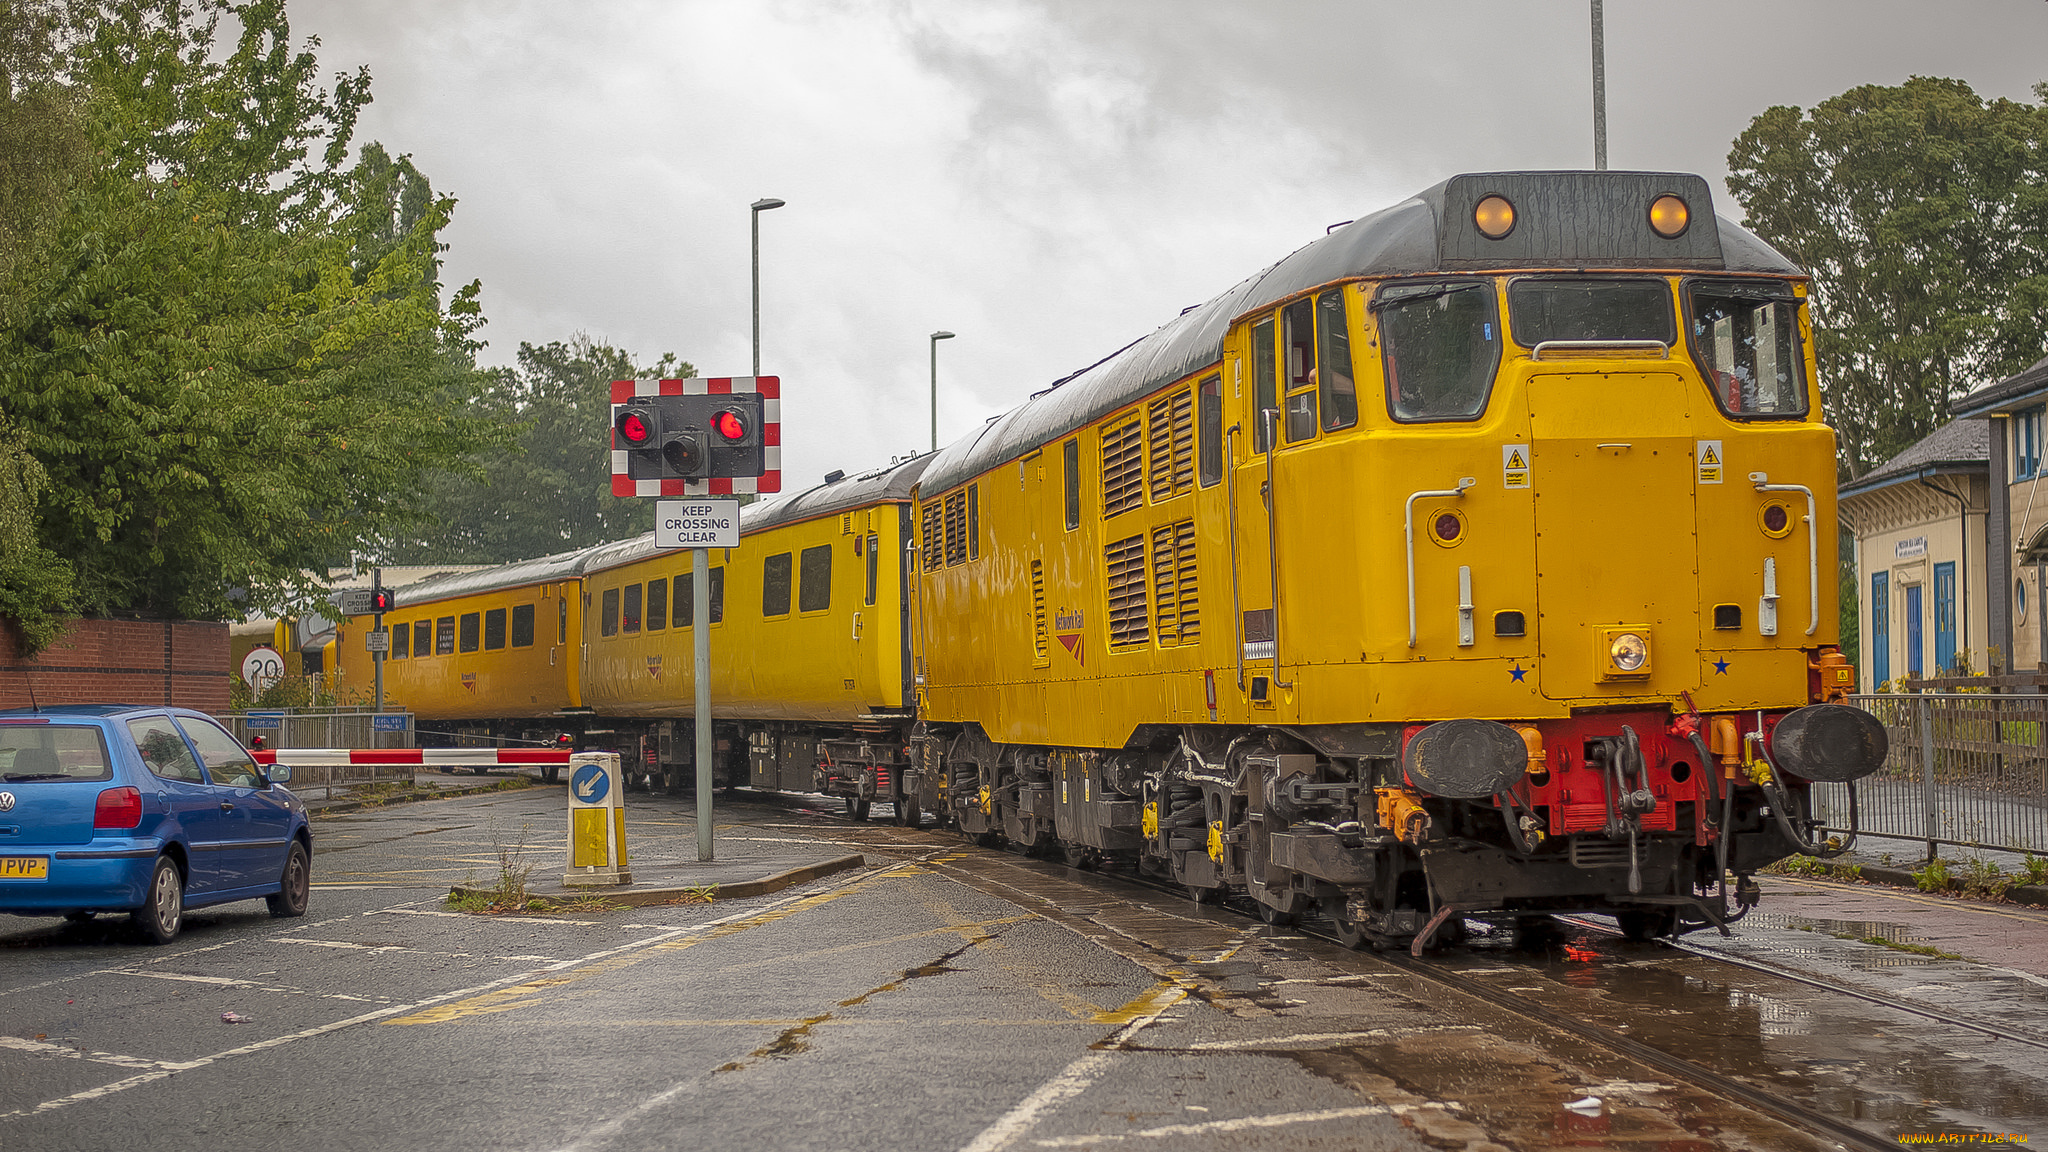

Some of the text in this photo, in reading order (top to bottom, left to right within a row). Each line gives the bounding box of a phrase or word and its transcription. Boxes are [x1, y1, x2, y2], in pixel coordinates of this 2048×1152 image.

[682, 505, 712, 516] KEEP
[665, 519, 730, 529] CROSSING
[678, 532, 716, 542] CLEAR
[251, 659, 278, 679] 20
[6, 859, 37, 874] PVP
